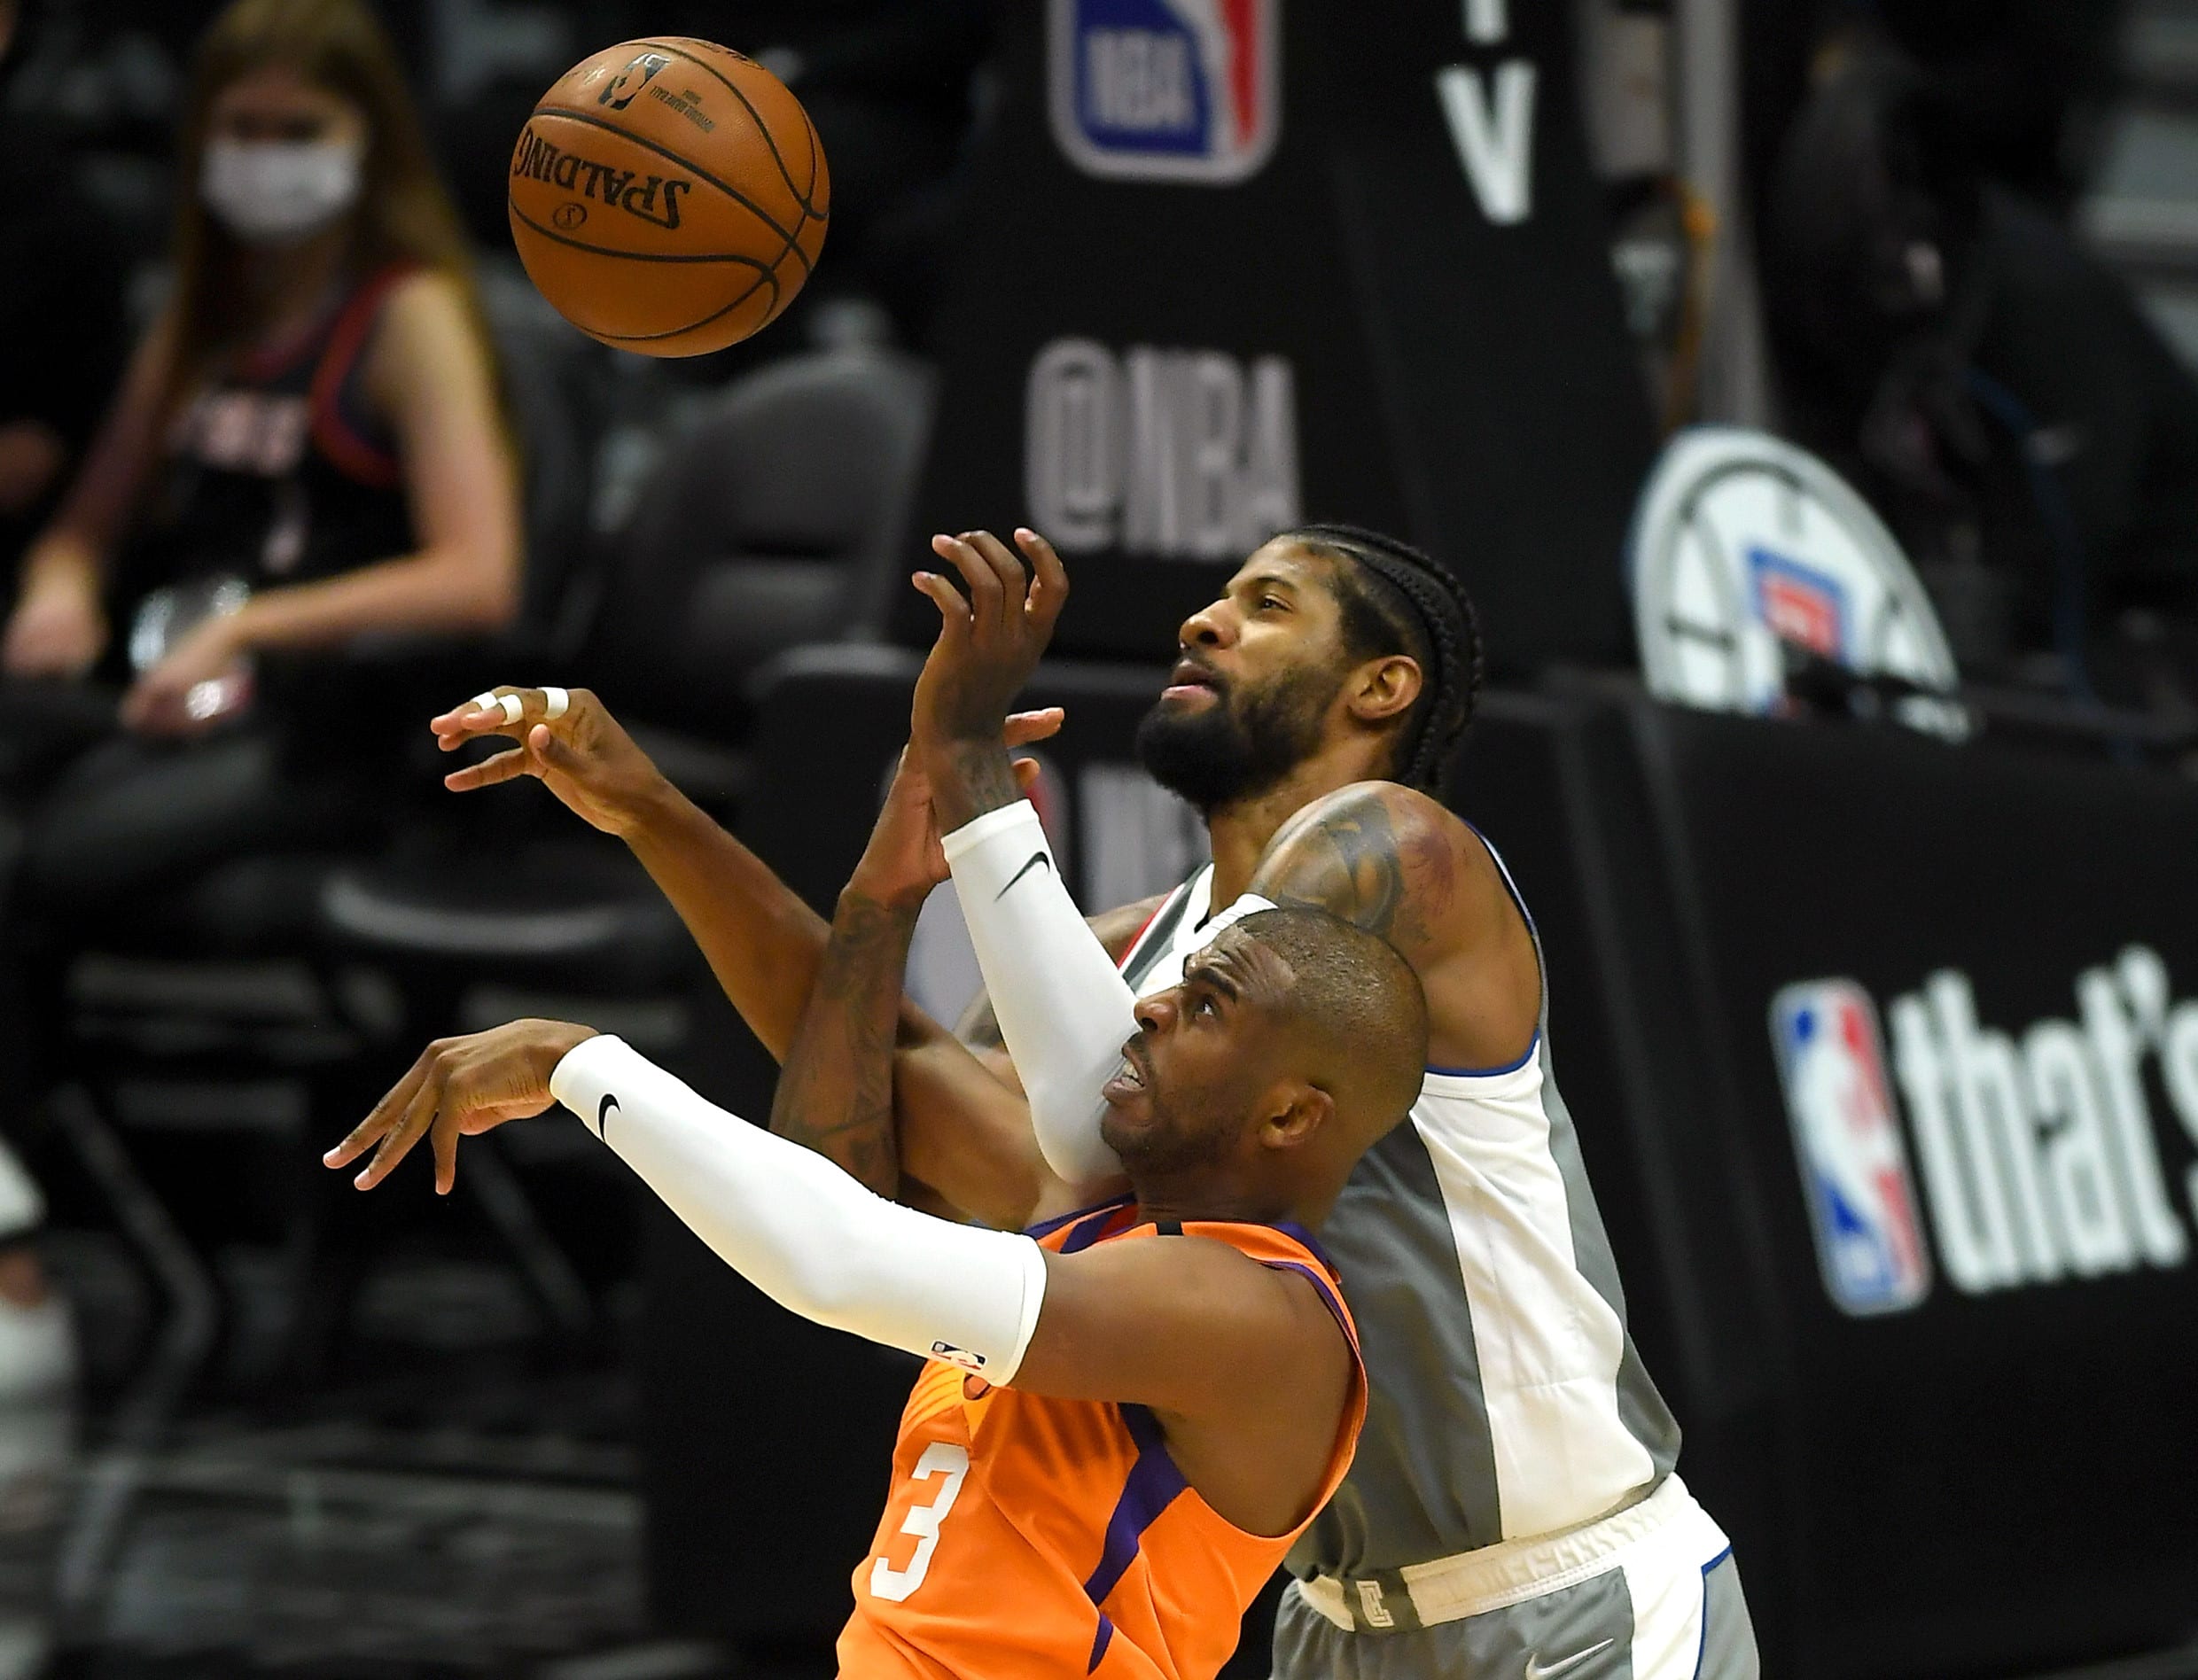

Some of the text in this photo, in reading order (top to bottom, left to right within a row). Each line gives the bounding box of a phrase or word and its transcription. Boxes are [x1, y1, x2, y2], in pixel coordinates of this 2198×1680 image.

[514, 127, 690, 229] SPALDING
[1024, 333, 1305, 564] @NBA
[870, 1441, 970, 1603] 3
